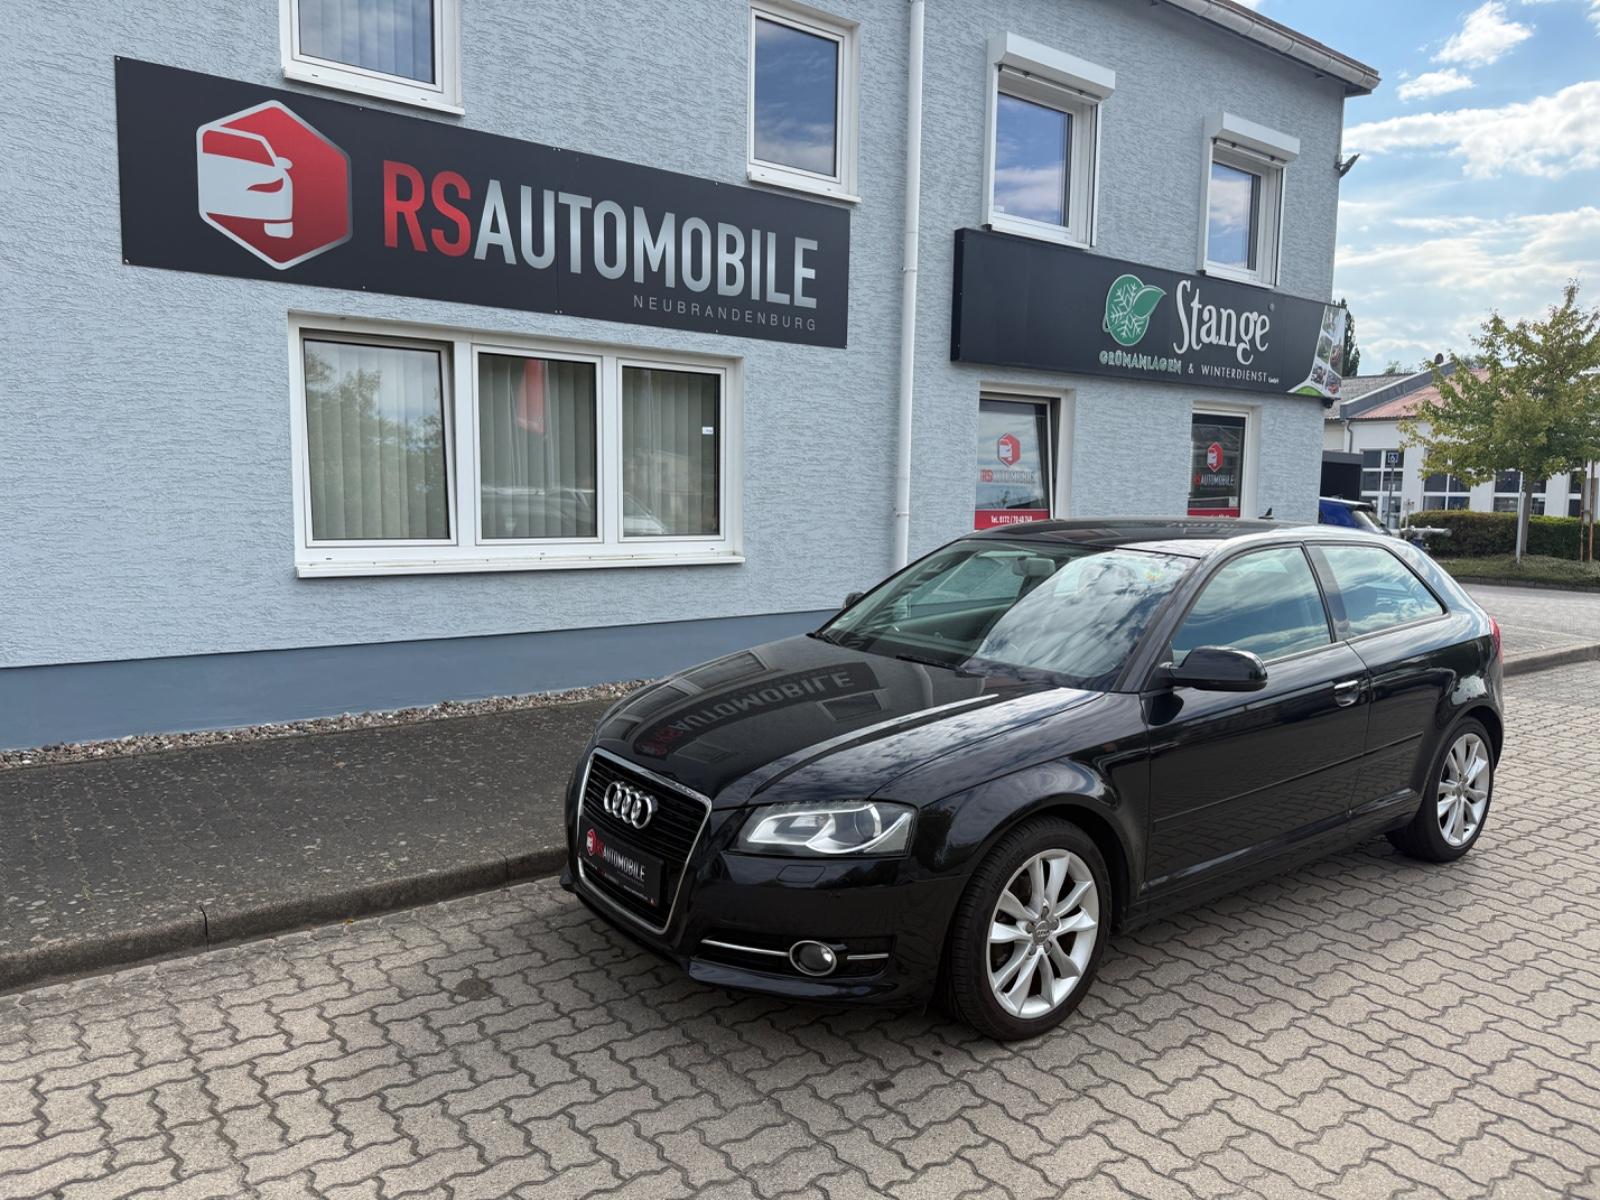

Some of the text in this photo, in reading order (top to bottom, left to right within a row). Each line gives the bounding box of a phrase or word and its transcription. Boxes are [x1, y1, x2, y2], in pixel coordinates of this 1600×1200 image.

[633, 294, 817, 332] NEUBRANDENBURG
[1173, 280, 1270, 365] Stange
[1099, 350, 1182, 375] GRÜNANLAGEN
[1188, 363, 1195, 374] &
[1201, 364, 1267, 383] WINTERDIENST
